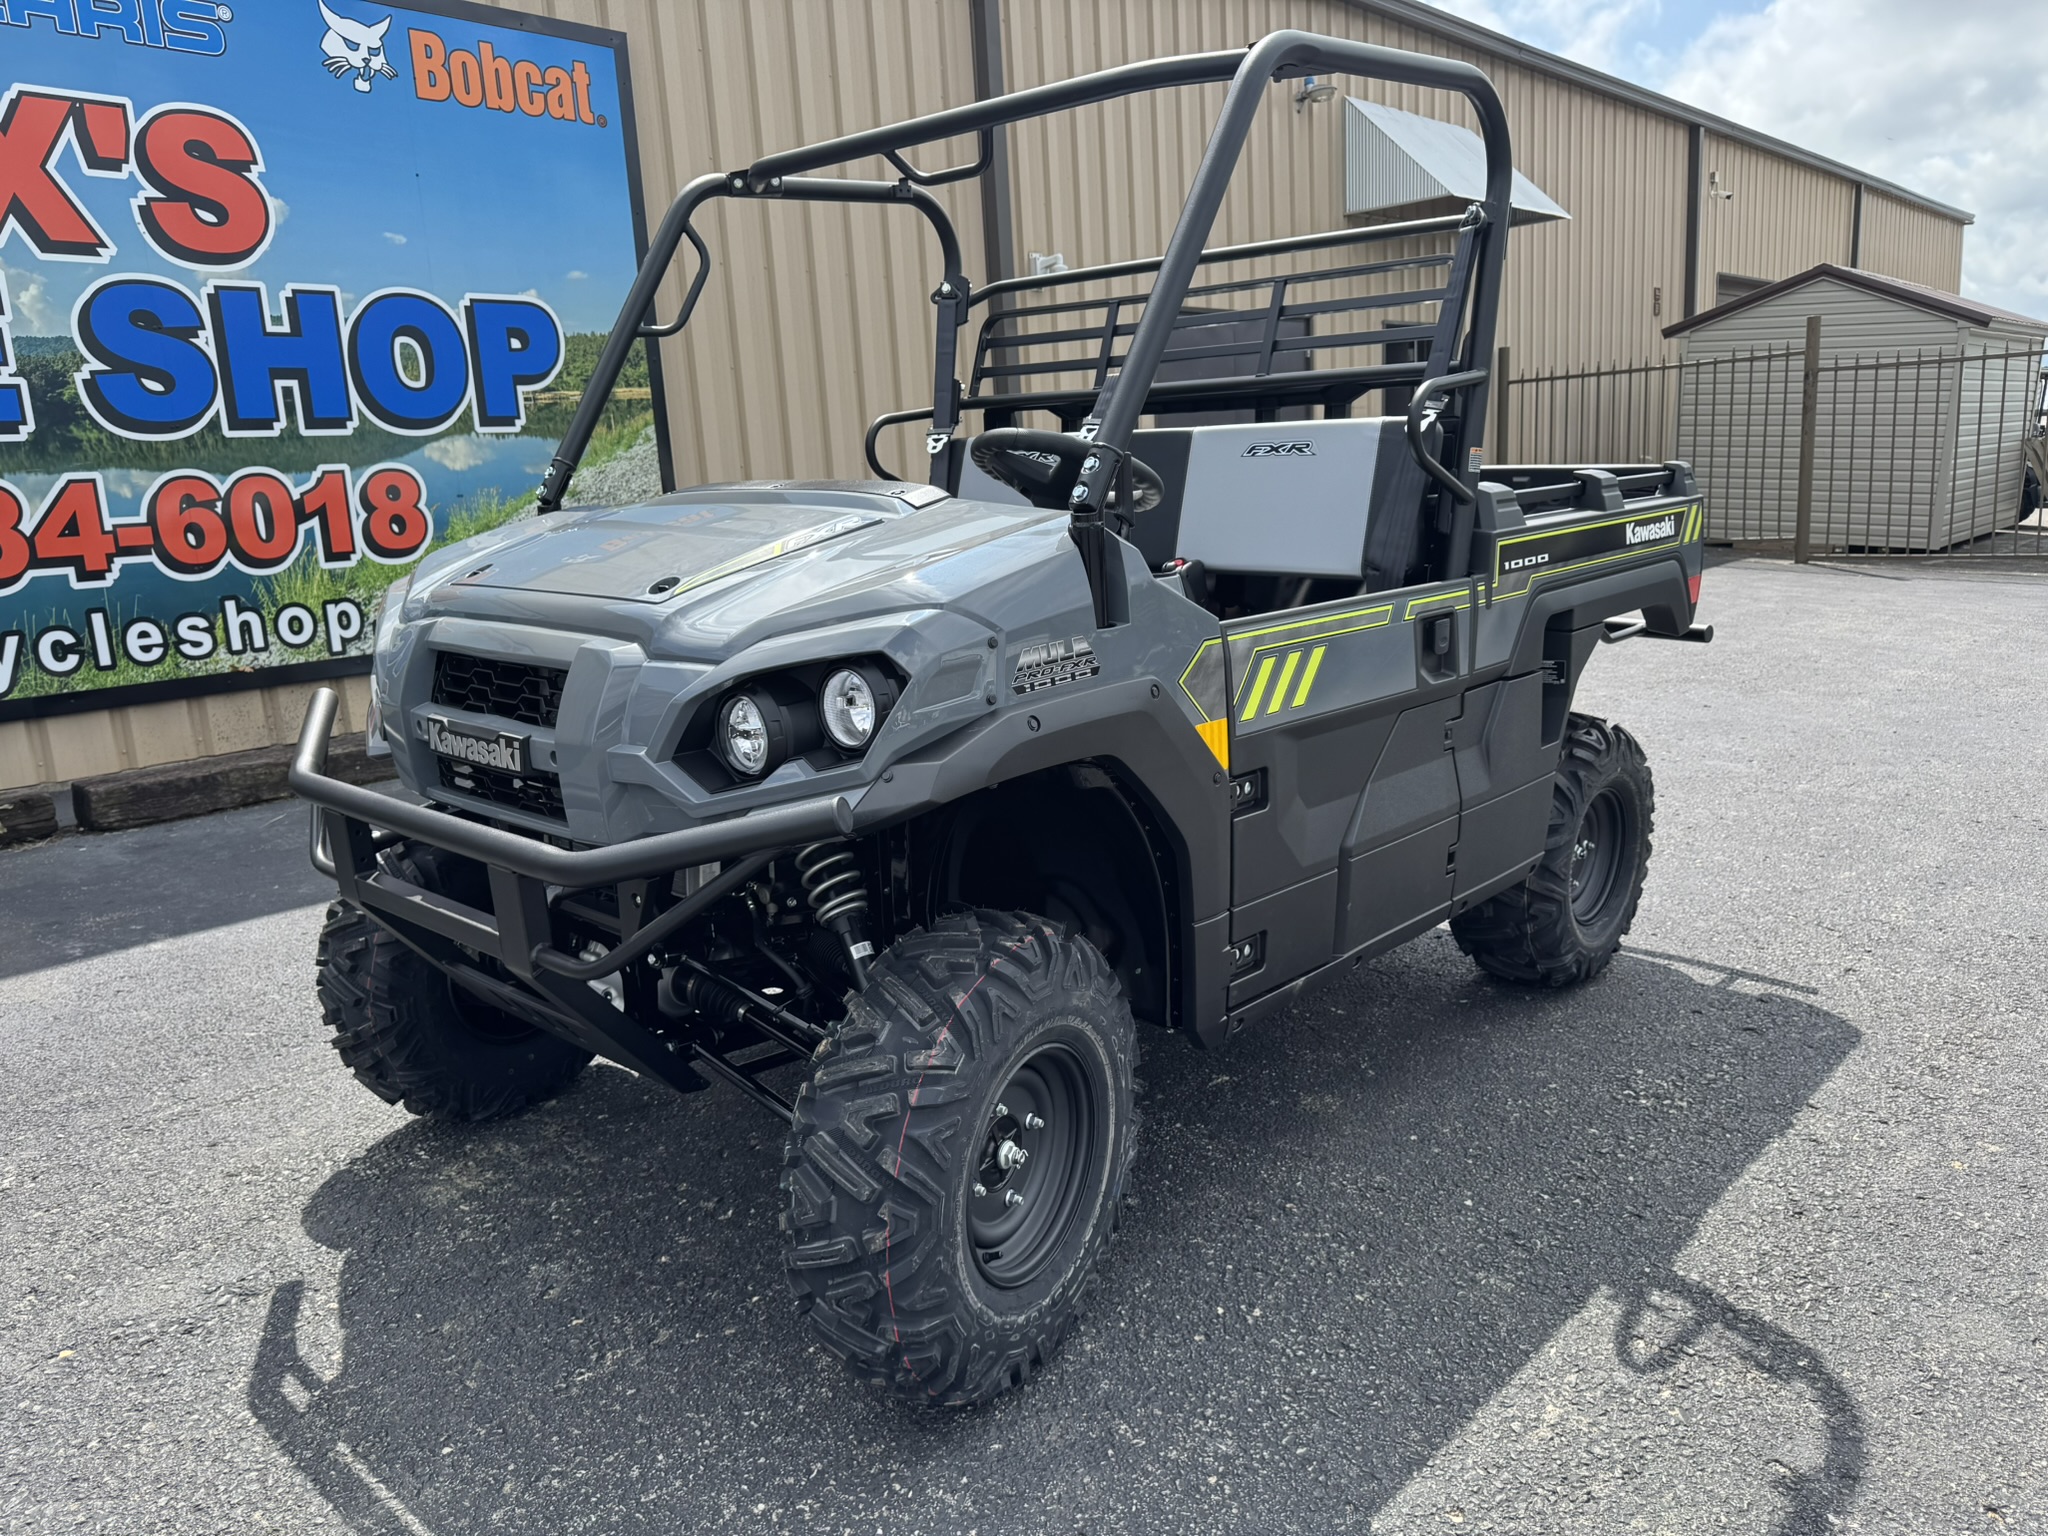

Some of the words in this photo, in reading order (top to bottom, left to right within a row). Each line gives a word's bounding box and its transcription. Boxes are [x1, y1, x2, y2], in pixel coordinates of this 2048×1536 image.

[0, 0, 227, 56] ARIS
[407, 27, 595, 125] Bobcat
[73, 273, 563, 441] SHOP
[1241, 441, 1316, 457] FXR
[1625, 516, 1675, 545] Kawasaki
[1504, 554, 1549, 570] 1000
[1015, 636, 1095, 673] MULE
[428, 721, 521, 772] Kawasaki
